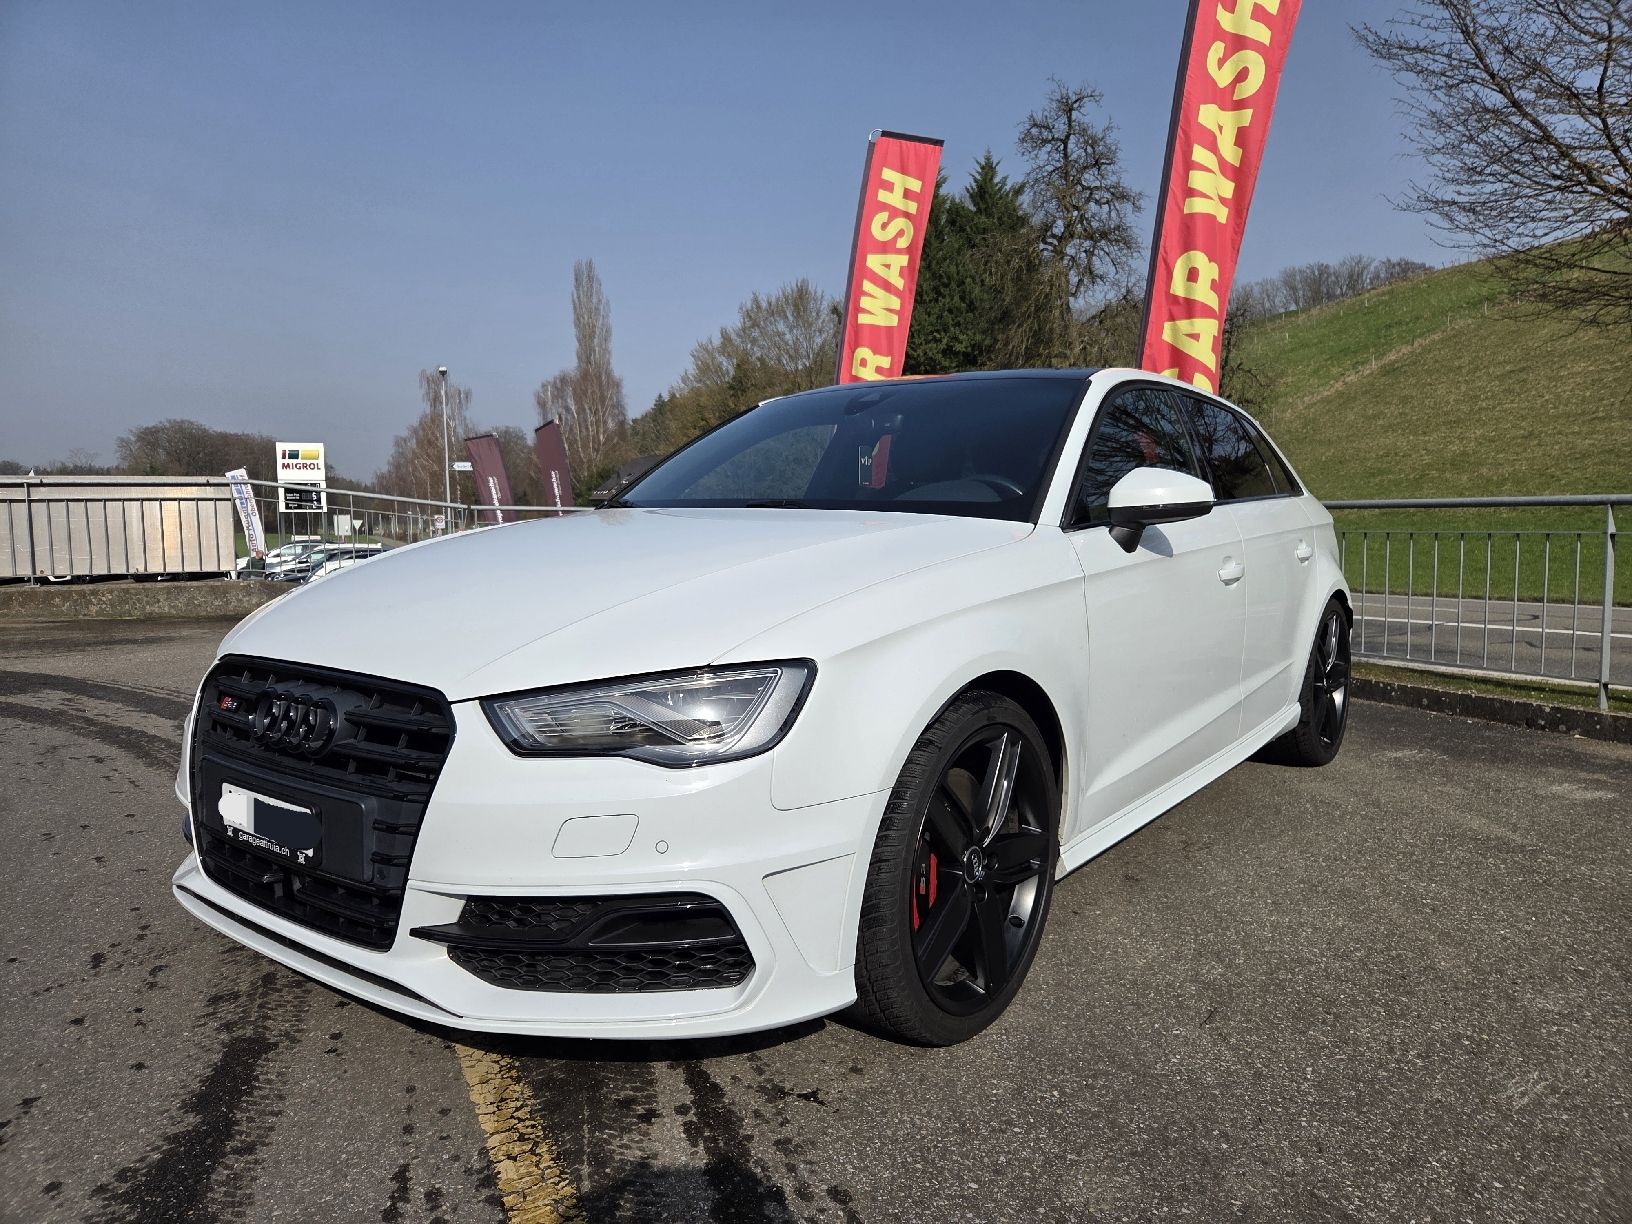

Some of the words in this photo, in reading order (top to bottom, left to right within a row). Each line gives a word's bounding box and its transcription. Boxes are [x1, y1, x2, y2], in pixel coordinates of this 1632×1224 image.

[1184, 0, 1281, 224] WASH
[857, 167, 923, 327] WASH
[281, 462, 321, 470] MIGROL
